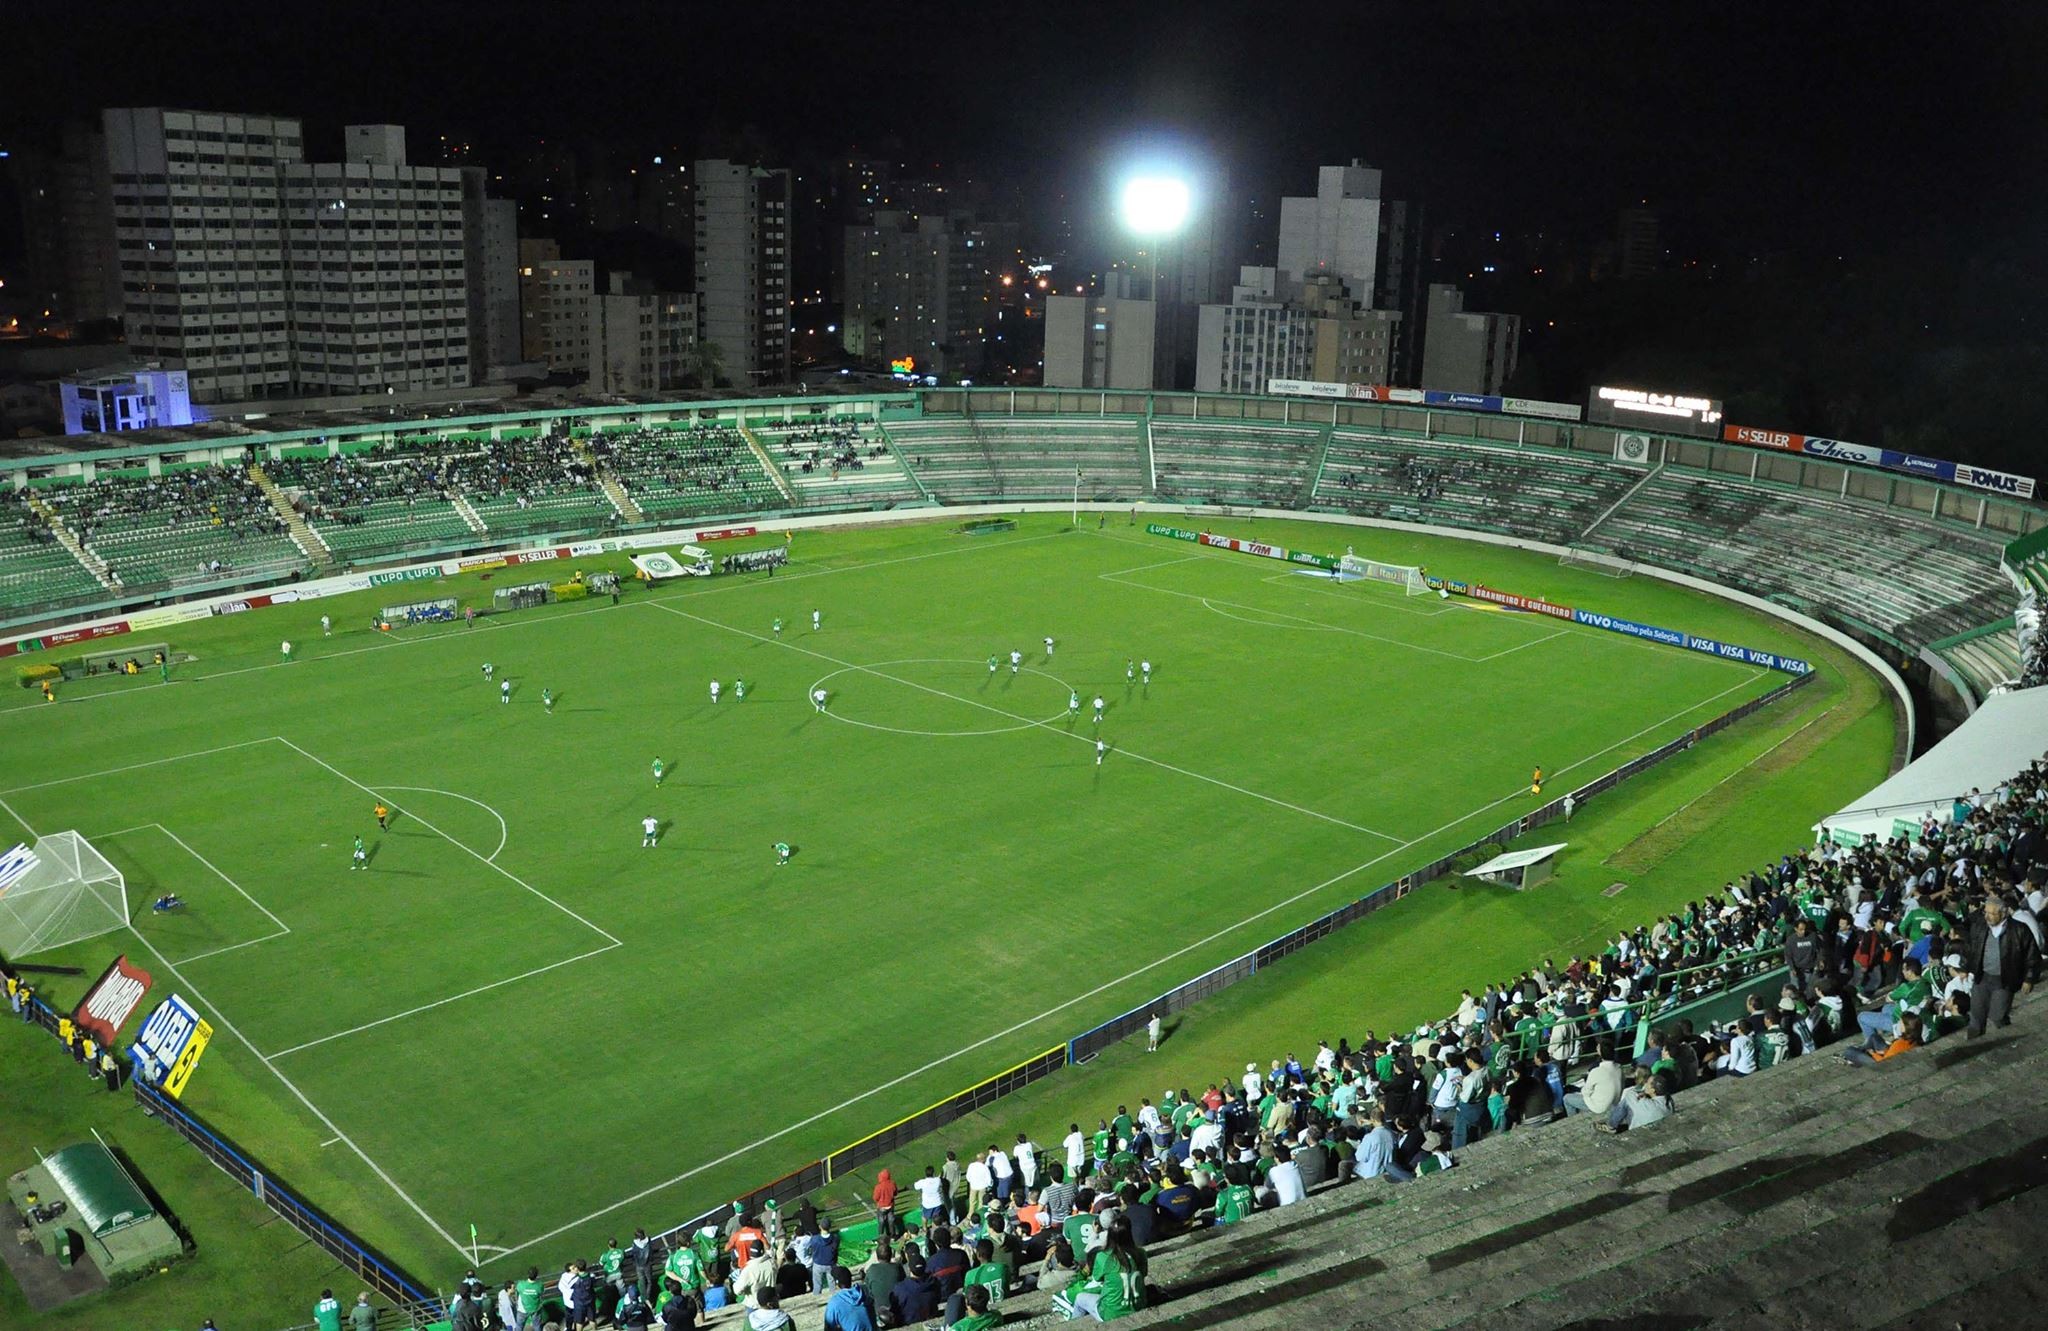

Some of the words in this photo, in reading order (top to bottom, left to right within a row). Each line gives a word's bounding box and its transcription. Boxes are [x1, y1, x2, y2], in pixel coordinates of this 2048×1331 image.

[1750, 430, 1790, 447] SELLER
[1804, 438, 1867, 462] Chico
[1970, 470, 2018, 492] TONUS
[1150, 524, 1171, 535] LUPO
[1175, 530, 1196, 540] LUPO
[529, 550, 558, 562] SELLER
[1248, 544, 1272, 556] TAM
[372, 572, 403, 585] LUPO
[406, 566, 436, 580] LUPO
[1448, 580, 1467, 594] Itaú
[1528, 601, 1570, 618] GUERREIRO
[1612, 620, 1638, 634] Orgulho
[1639, 628, 1653, 636] pela
[1690, 638, 1714, 652] VISA
[1720, 644, 1744, 659] VISA
[1749, 651, 1774, 666] VISA
[1779, 658, 1805, 673] VISA
[87, 966, 144, 1032] BRAHMA
[172, 1044, 197, 1088] G
[1080, 1224, 1094, 1244] 9
[612, 1259, 620, 1270] 9
[680, 1266, 690, 1279] 9
[983, 1278, 1004, 1304] 13
